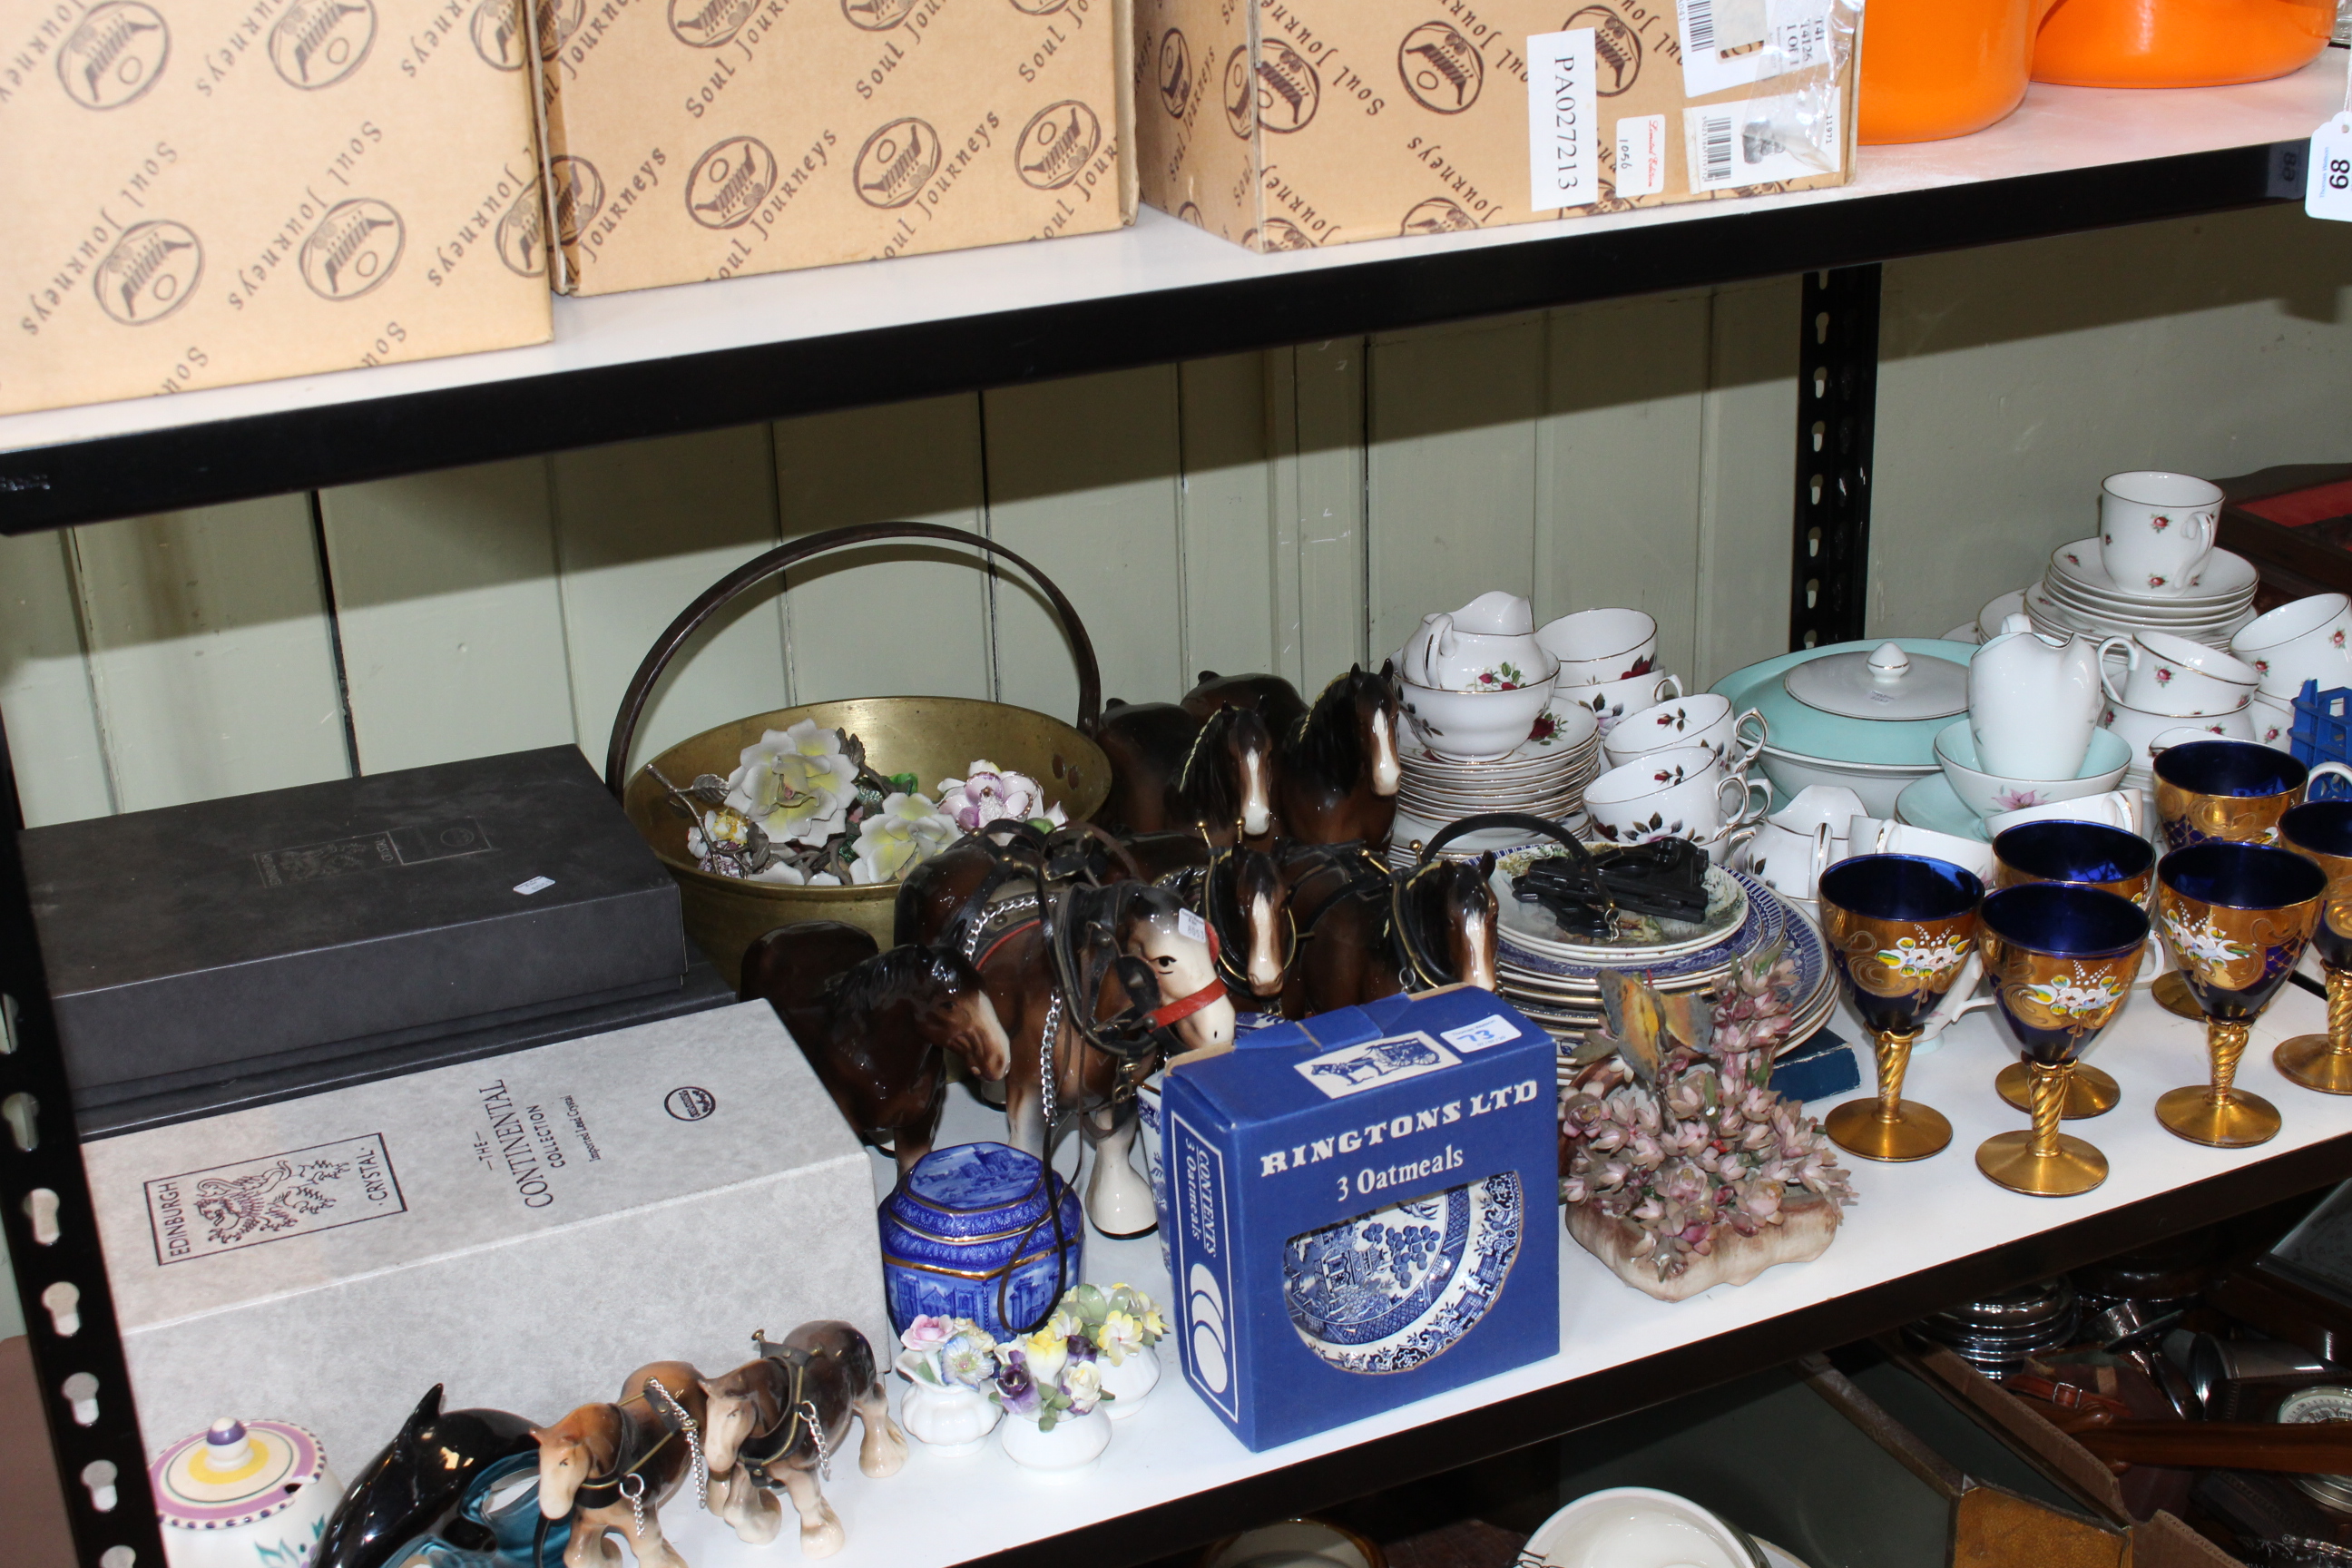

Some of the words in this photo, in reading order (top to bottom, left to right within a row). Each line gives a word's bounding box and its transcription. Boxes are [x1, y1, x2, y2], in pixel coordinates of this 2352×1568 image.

[856, 41, 905, 100] Soul
[1018, 25, 1066, 83] Soul
[685, 57, 736, 119] Soul
[1333, 65, 1386, 116] Soul
[1554, 54, 1578, 190] PA027213
[121, 142, 177, 208] Soul
[328, 121, 382, 186] Soul
[1170, 132, 1186, 181] Soul
[1233, 154, 1254, 207] Soul
[2329, 159, 2350, 190] 68
[868, 218, 916, 261] oul
[1030, 200, 1074, 241] oul
[705, 238, 752, 281] oul
[1456, 1029, 1495, 1042] 73
[559, 1094, 579, 1117] Crystal
[569, 1116, 587, 1133] Lead
[1259, 1100, 1461, 1177] RINGTONS
[1469, 1079, 1539, 1117] LTD
[478, 1079, 554, 1208] CONTINENTAL
[526, 1104, 566, 1169] COLLECTION
[576, 1132, 601, 1162] Imported
[1185, 1138, 1195, 1152] 3
[1186, 1155, 1202, 1240] Oatmeals
[1337, 1177, 1348, 1202] 3
[1357, 1144, 1464, 1195] Oatmeals
[158, 1181, 191, 1258] EDINBURGH
[1198, 1150, 1217, 1258] CONTENTS
